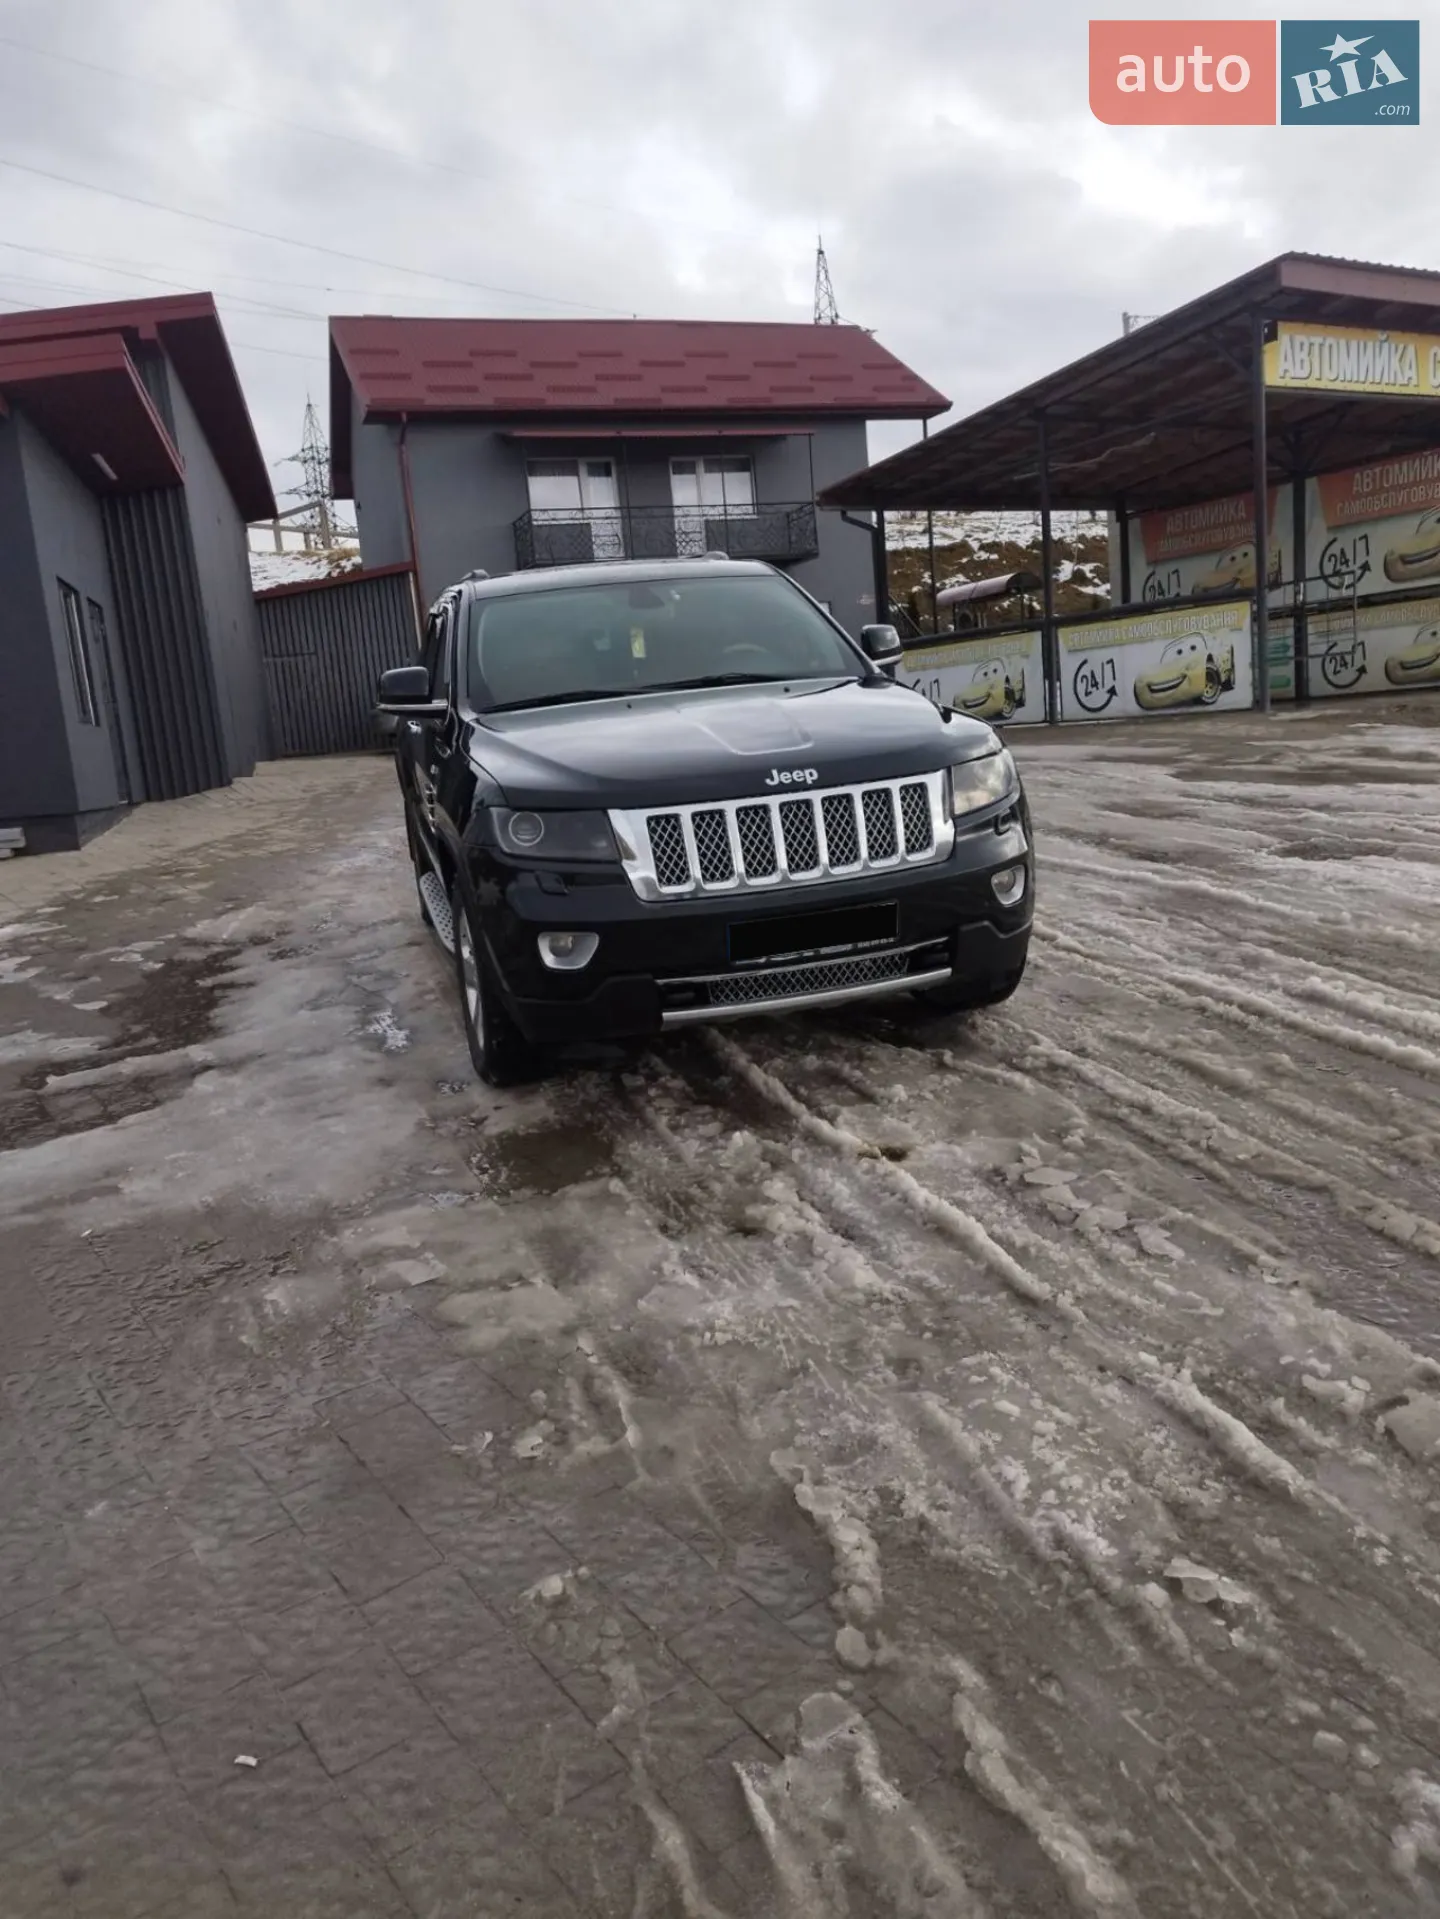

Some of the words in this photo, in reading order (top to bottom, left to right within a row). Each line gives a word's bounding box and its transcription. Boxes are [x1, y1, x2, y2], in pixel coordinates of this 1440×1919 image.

[1278, 330, 1420, 387] АВТОМИЙКА
[1166, 498, 1247, 533] АВТОМИЙКА
[1328, 534, 1370, 575] 24/7
[1148, 568, 1181, 600] 24/7
[1329, 641, 1367, 676] 24/7
[1081, 658, 1117, 697] 24/7
[764, 768, 819, 786] Jeep
